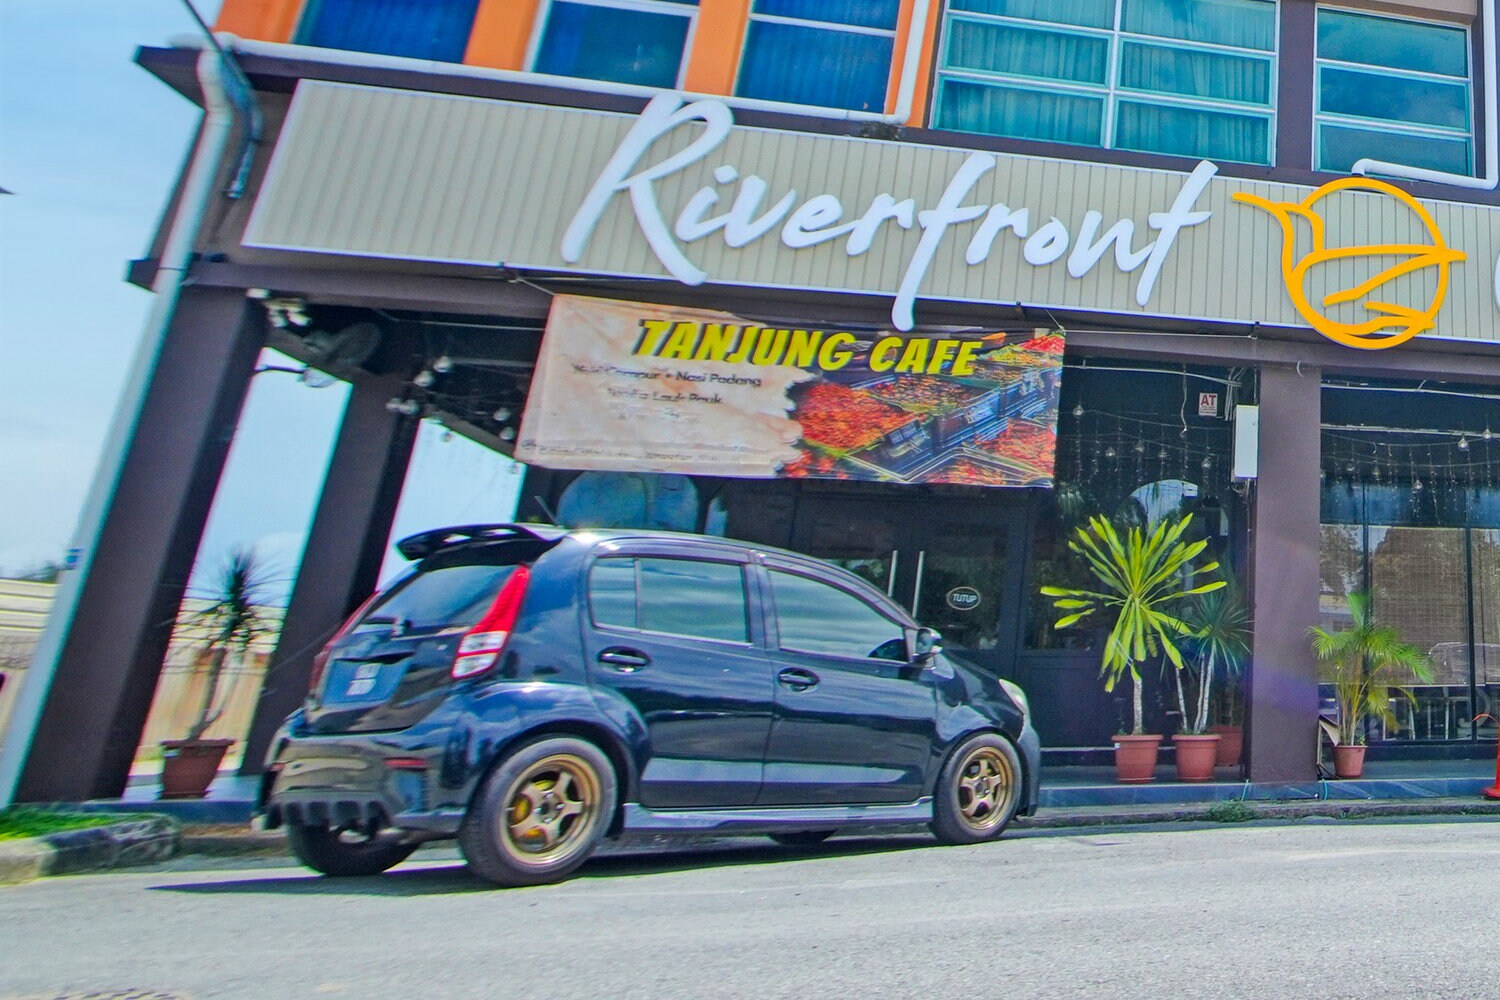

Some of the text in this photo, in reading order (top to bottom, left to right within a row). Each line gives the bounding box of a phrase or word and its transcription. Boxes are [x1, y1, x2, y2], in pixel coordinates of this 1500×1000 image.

[561, 92, 1219, 332] Riverfront
[630, 319, 982, 377] TANJUNG CAFE
[676, 370, 706, 382] Nasi
[710, 373, 762, 388] Padang
[1200, 394, 1217, 406] AT
